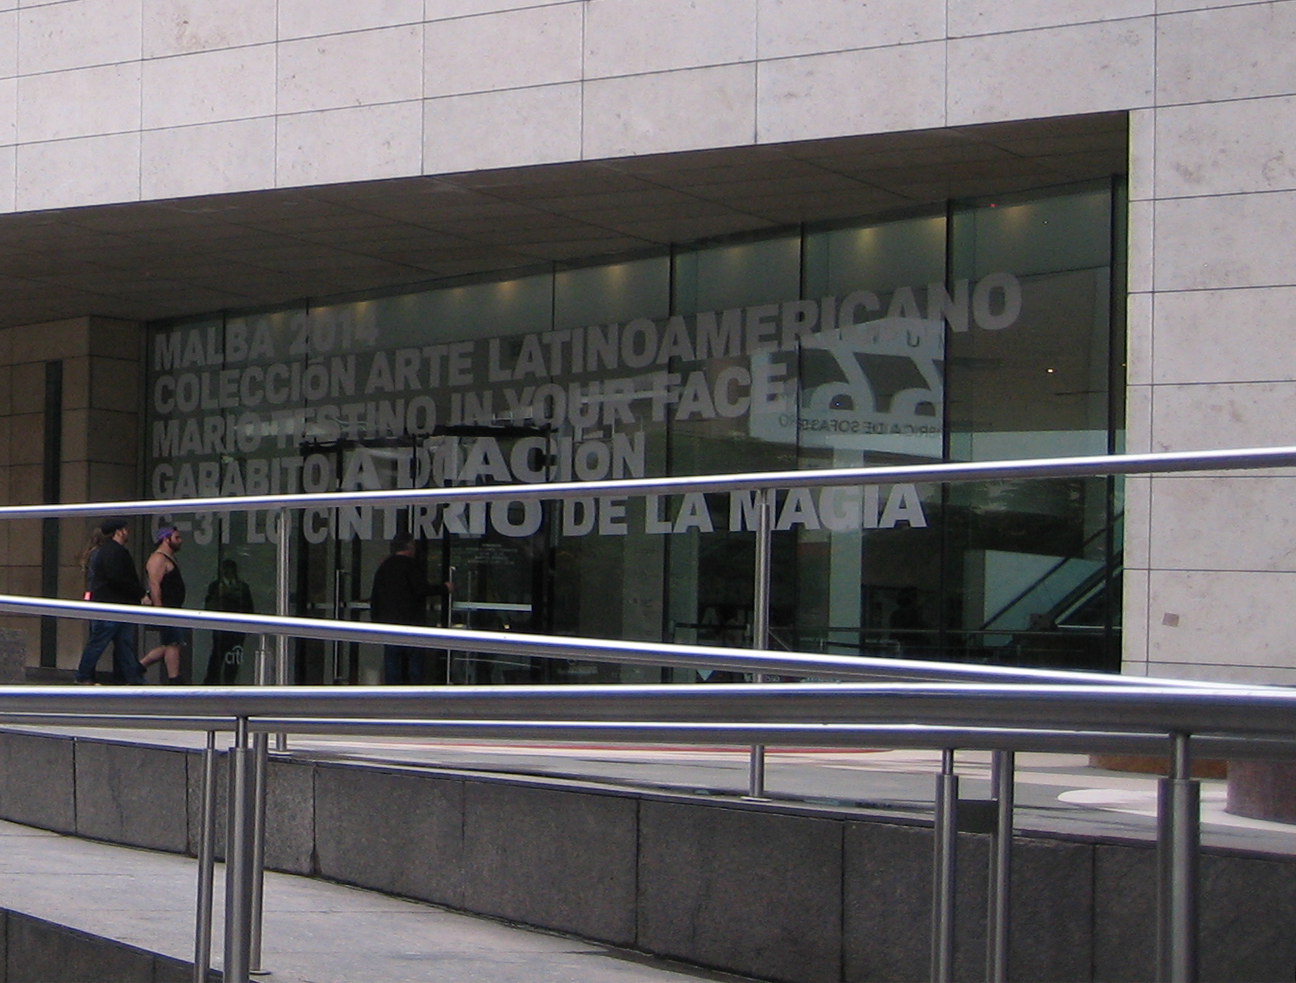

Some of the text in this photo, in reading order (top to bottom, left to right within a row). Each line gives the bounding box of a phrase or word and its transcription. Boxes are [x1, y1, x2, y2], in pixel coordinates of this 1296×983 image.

[154, 304, 379, 371] MALBA 2014
[154, 272, 1022, 414] COLECCIÓN ARTE LATINOAMERICANO
[153, 351, 788, 458] MARIO TESTINO IN YOUR FACE
[152, 454, 328, 499] GARABITO
[563, 495, 627, 536] DE
[645, 492, 713, 534] LA
[730, 483, 927, 532] MAGIA
